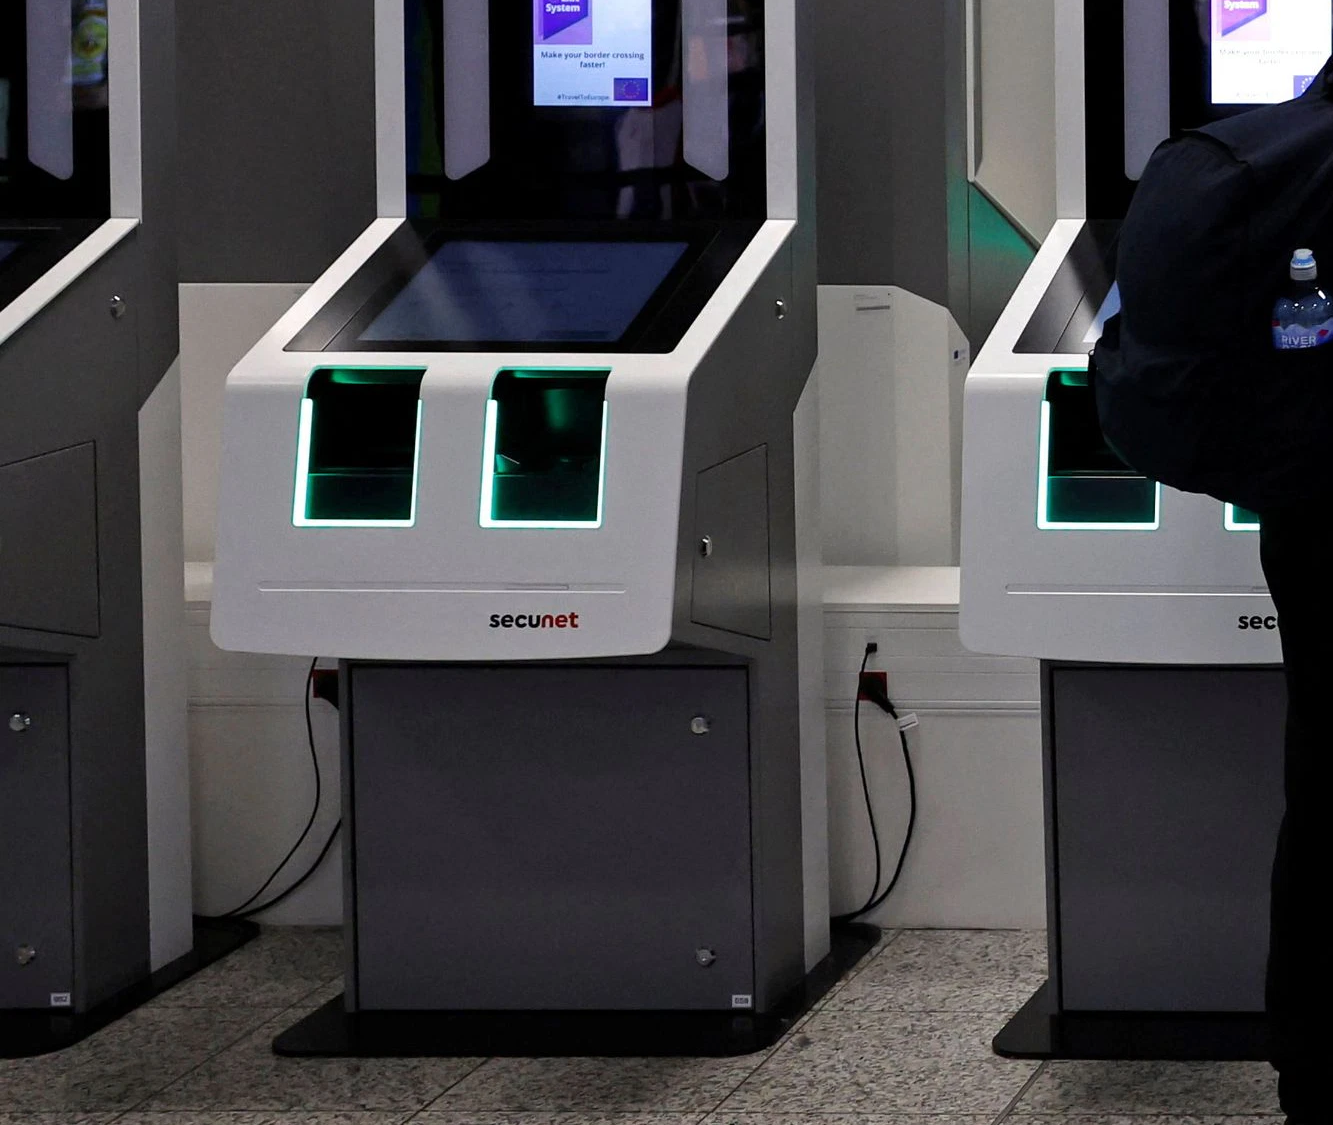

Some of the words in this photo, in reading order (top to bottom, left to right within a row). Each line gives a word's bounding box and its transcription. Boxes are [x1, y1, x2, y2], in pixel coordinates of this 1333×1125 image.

[545, 3, 580, 14] System
[1223, 0, 1259, 11] System
[541, 51, 563, 59] Make
[564, 52, 582, 61] your
[584, 51, 610, 59] border
[612, 51, 644, 61] crossing
[1281, 335, 1317, 346] RIVER
[489, 612, 579, 628] secunet
